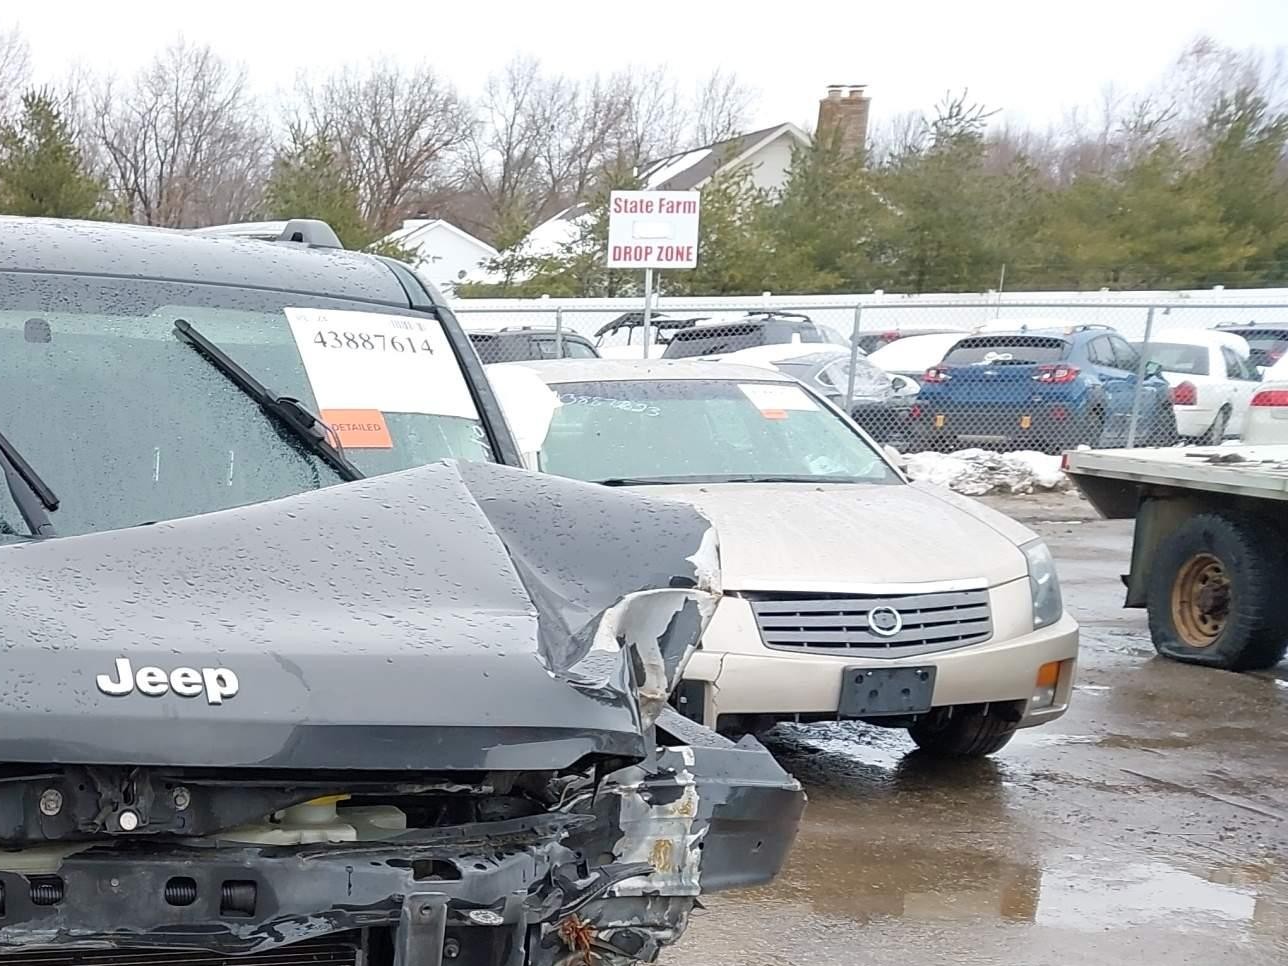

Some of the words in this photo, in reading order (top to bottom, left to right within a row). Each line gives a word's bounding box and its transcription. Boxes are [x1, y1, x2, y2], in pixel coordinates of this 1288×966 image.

[613, 197, 654, 214] State
[658, 197, 697, 214] Farm
[612, 245, 653, 262] DROP
[656, 245, 694, 262] ZONE
[313, 330, 435, 356] 43887614
[331, 423, 381, 432] DETAILED
[96, 656, 240, 706] Jeep
